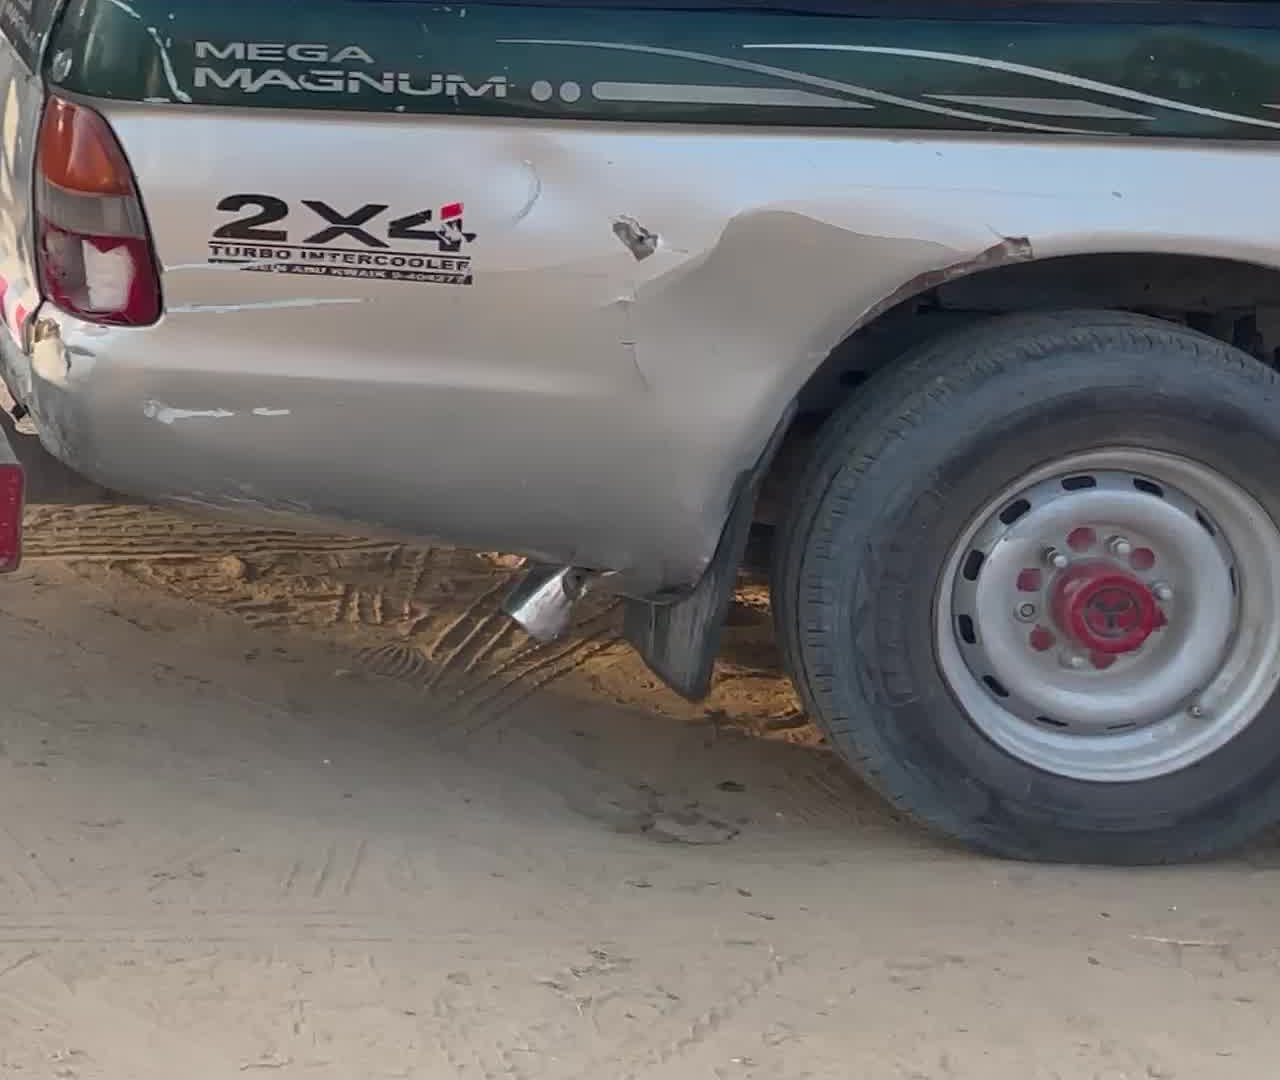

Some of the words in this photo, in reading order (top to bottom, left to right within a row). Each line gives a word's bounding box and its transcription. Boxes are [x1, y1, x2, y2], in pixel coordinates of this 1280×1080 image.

[194, 41, 375, 64] MEGA
[193, 67, 508, 98] MAGNUM
[208, 245, 291, 260] TURBO
